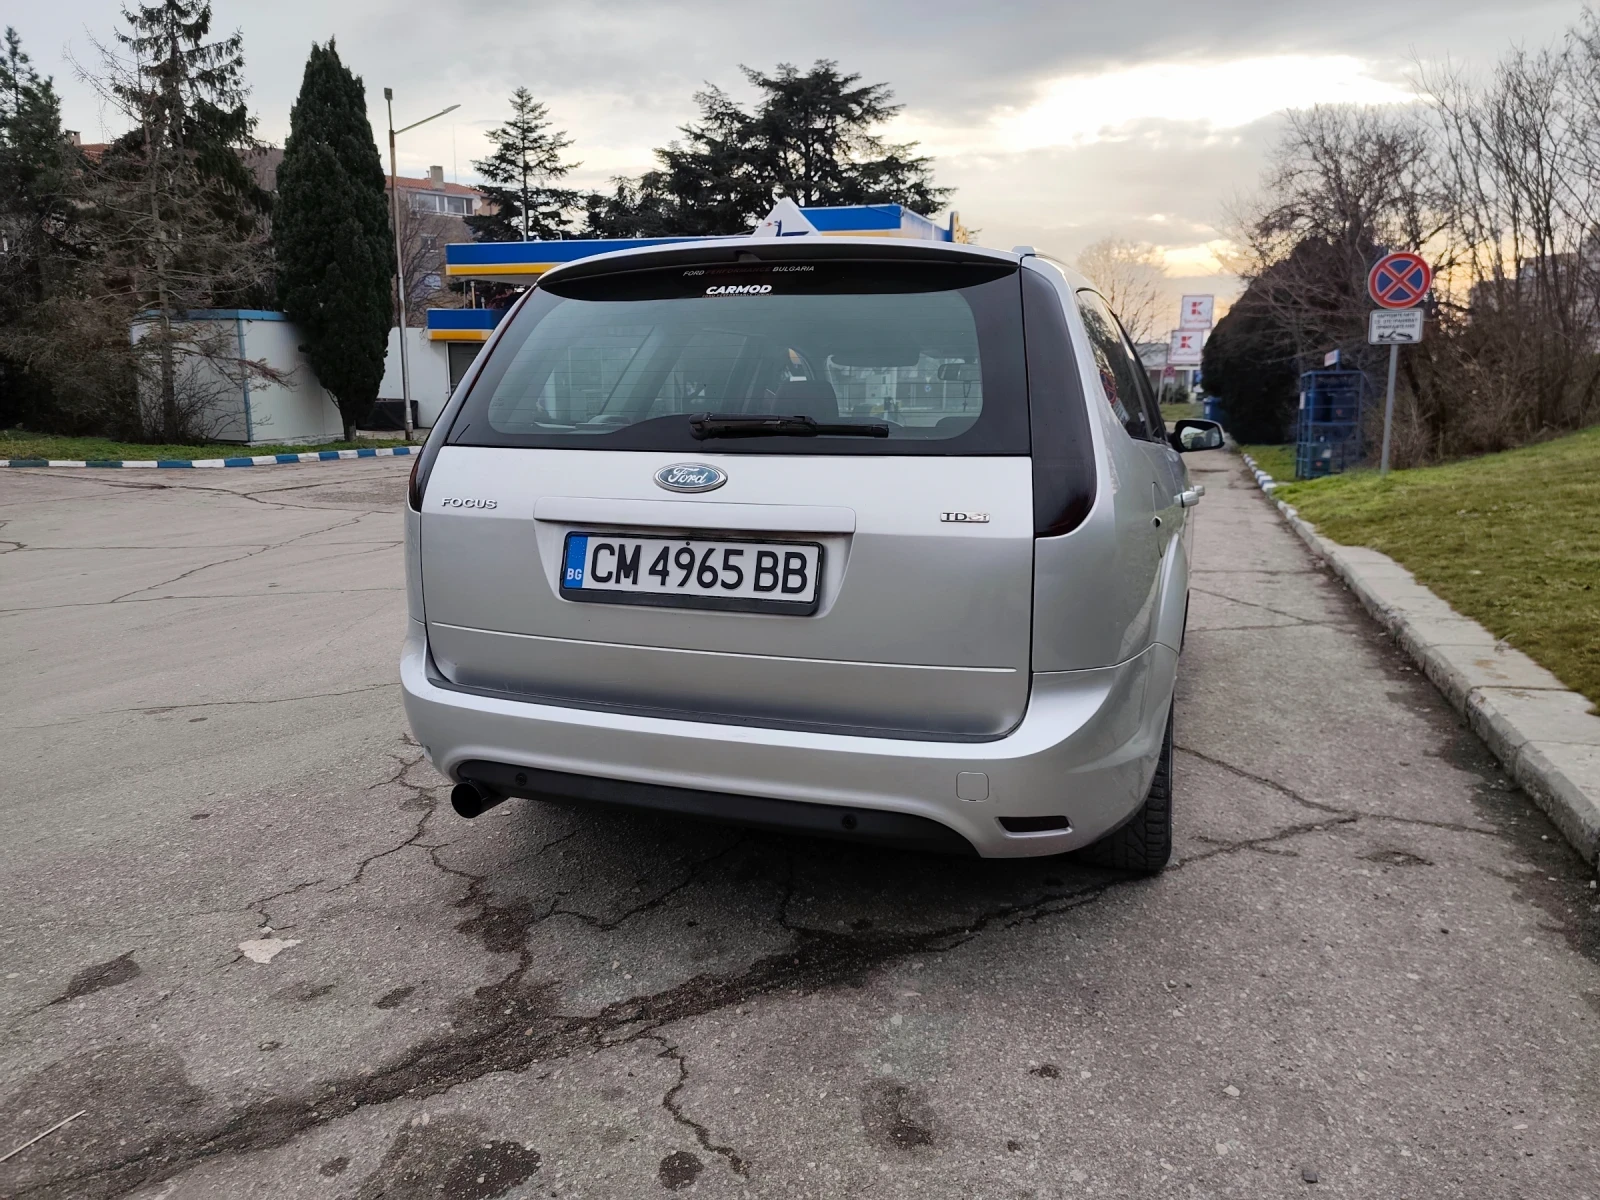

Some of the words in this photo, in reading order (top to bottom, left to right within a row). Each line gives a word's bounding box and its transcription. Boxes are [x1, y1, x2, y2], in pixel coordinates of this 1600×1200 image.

[706, 285, 773, 294] CARMOD
[668, 467, 708, 483] Ford
[441, 497, 498, 509] FOCUS
[566, 568, 583, 580] BG
[590, 543, 642, 585] CM
[648, 546, 744, 590] 4965
[753, 550, 808, 594] BB
